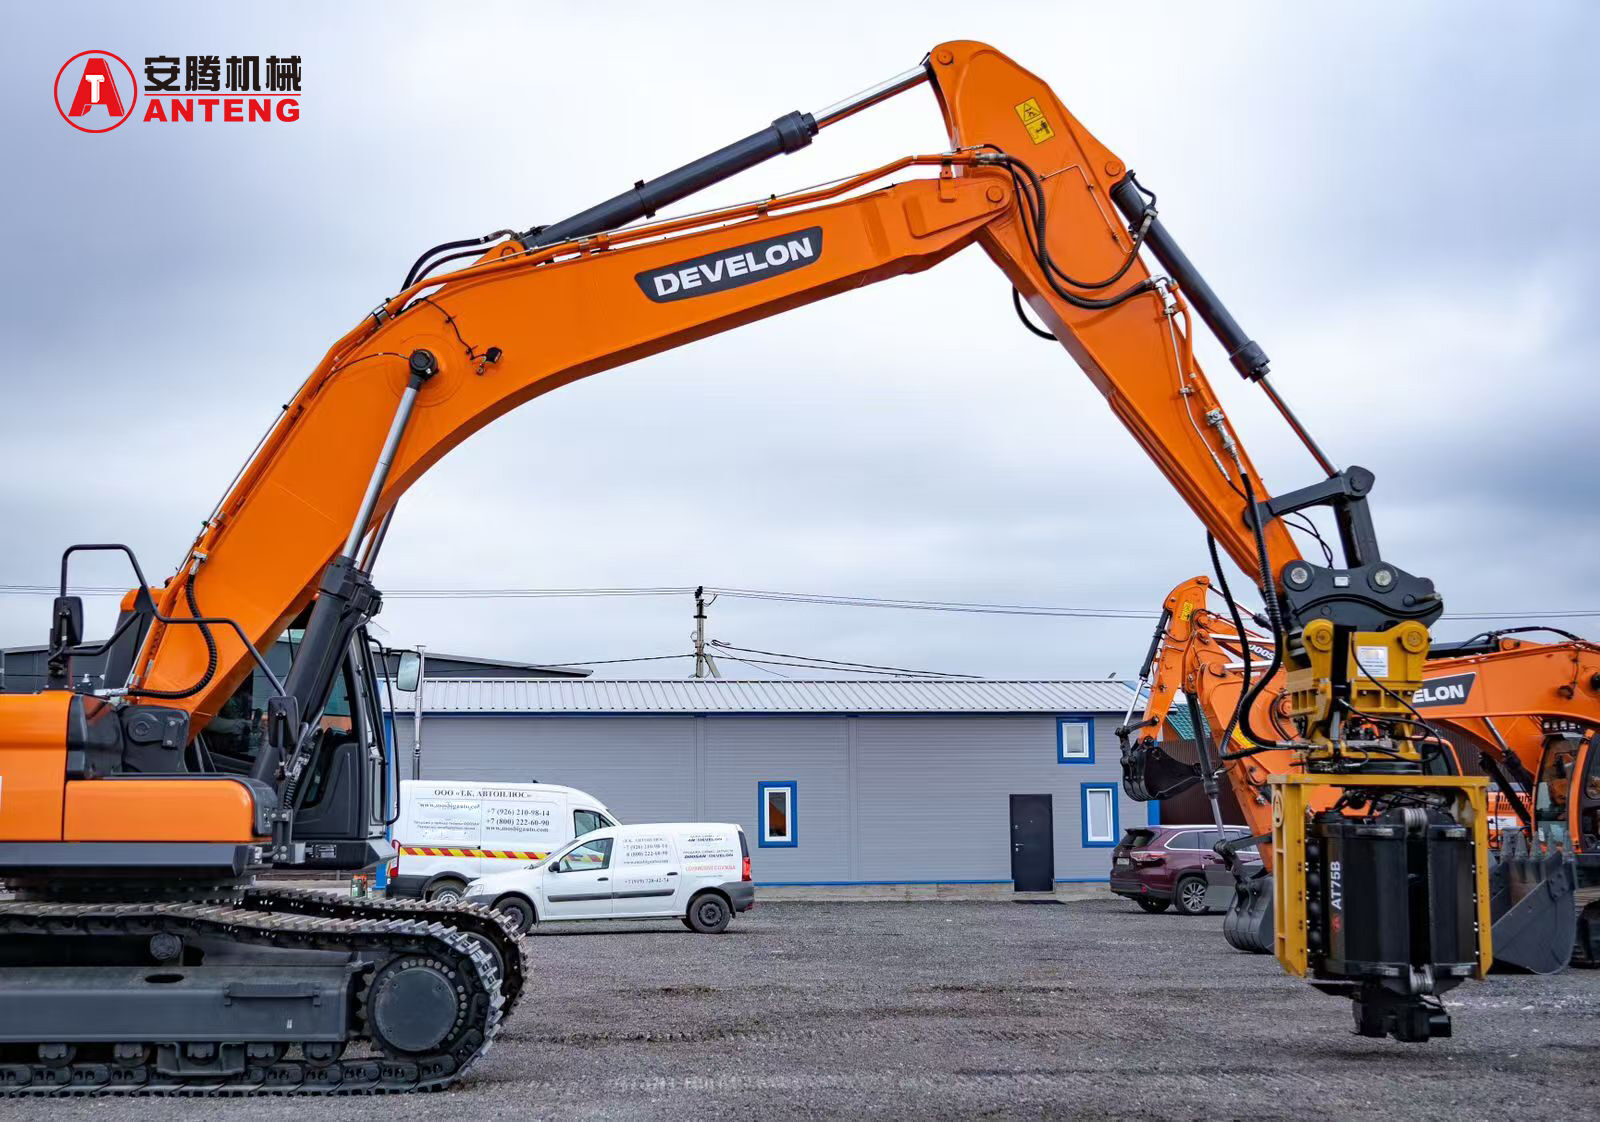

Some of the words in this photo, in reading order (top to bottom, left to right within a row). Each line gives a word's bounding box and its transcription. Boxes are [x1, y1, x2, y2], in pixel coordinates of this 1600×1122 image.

[653, 237, 814, 296] DEVELON
[486, 817, 495, 825] +7
[496, 818, 515, 826] (800)
[515, 818, 550, 827] 222-60-90
[496, 808, 515, 816] (926)
[516, 809, 550, 817] 210-98-14
[1330, 861, 1342, 910] AT75B
